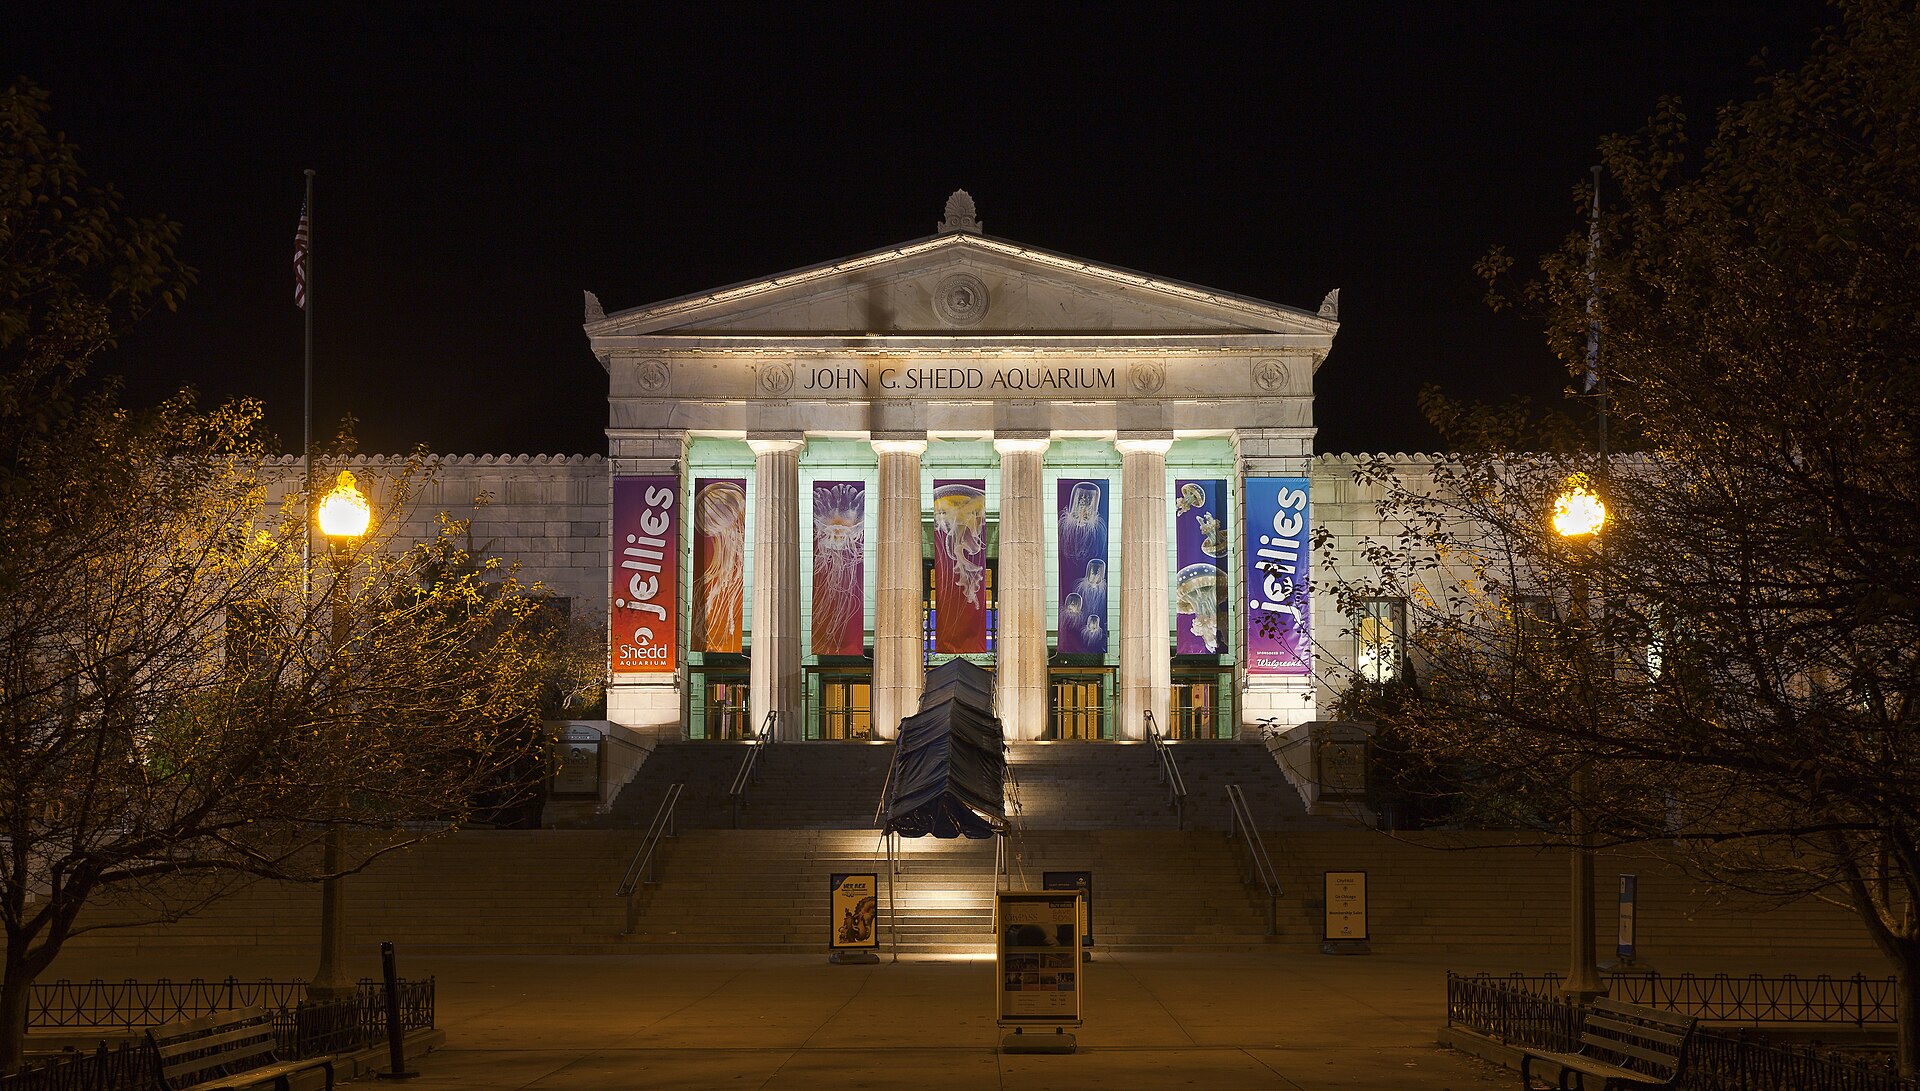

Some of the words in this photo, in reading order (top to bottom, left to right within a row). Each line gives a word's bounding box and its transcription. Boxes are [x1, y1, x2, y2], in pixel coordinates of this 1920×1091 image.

[803, 367, 869, 390] JOHN
[879, 368, 902, 389] G.
[905, 368, 985, 389] SHEDD
[990, 368, 1116, 391] AQUARIUM
[615, 485, 674, 621] jellies
[1249, 486, 1307, 624] jellies
[619, 643, 668, 660] Shedd
[1256, 658, 1302, 670] Walgreens
